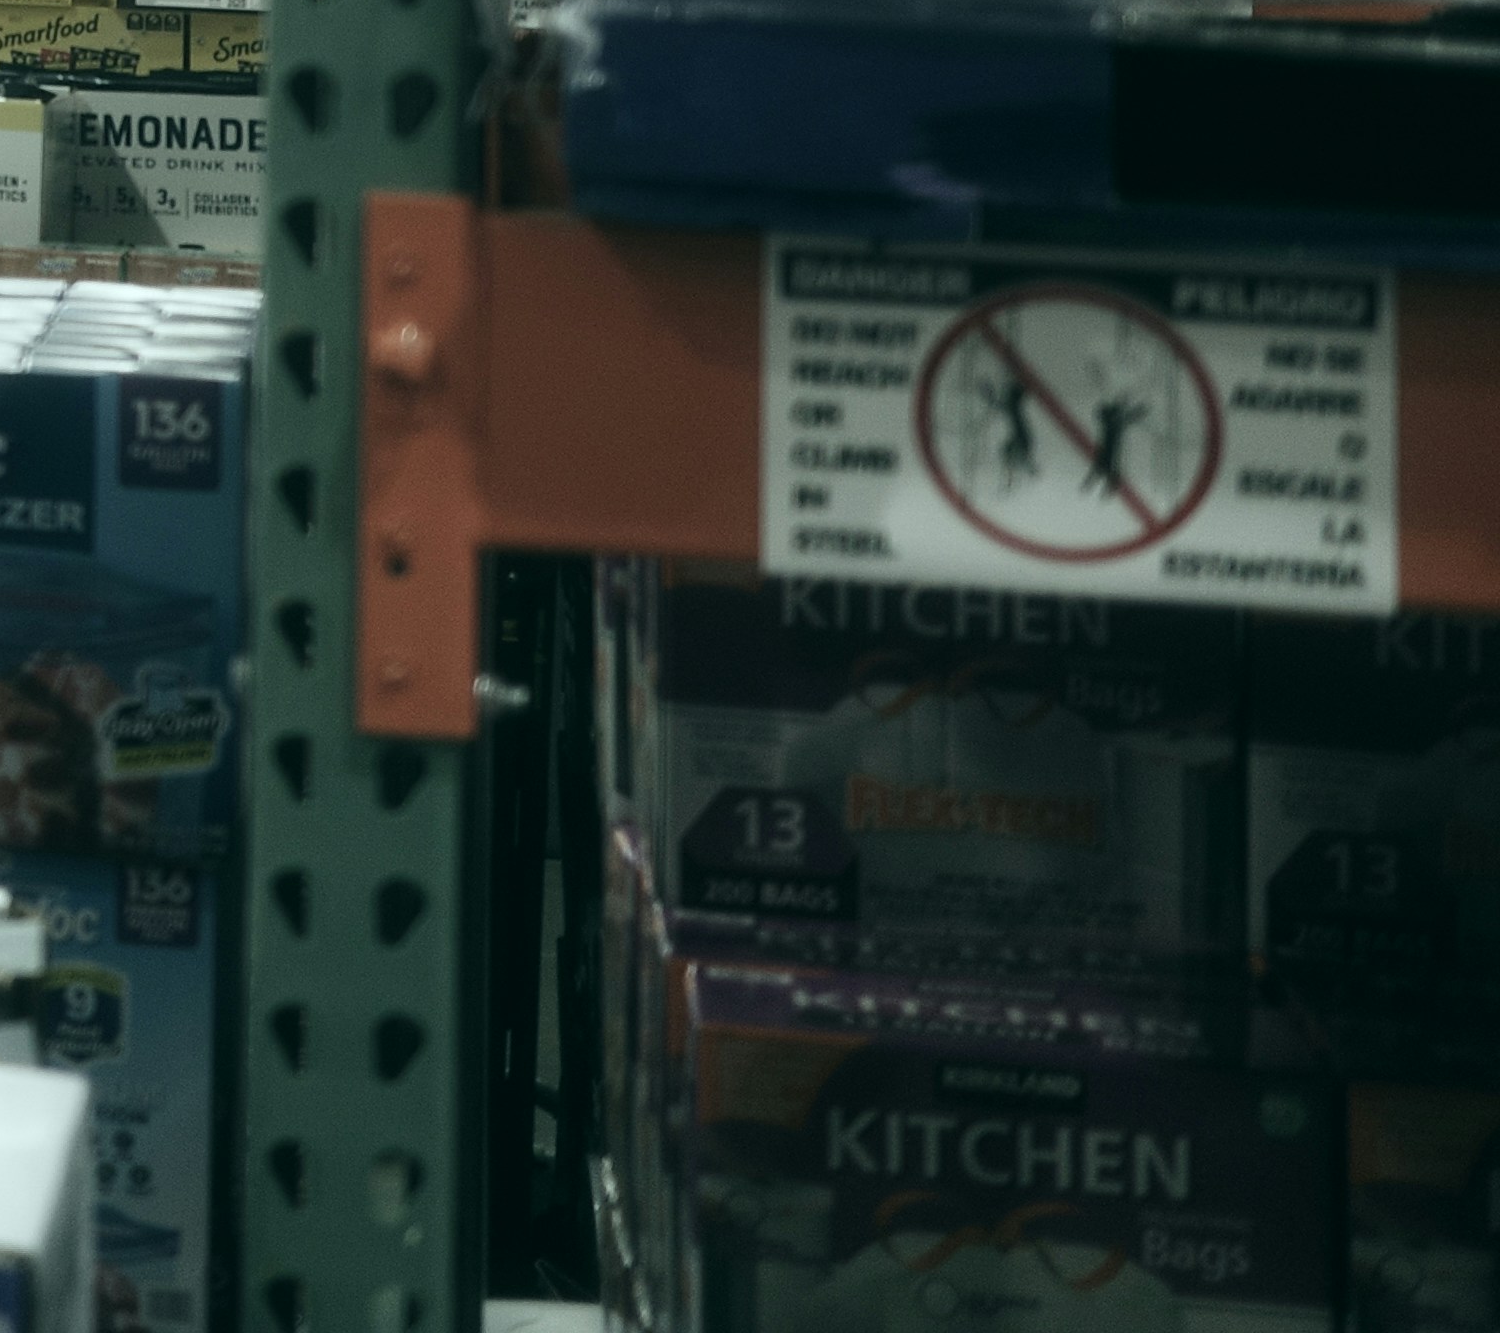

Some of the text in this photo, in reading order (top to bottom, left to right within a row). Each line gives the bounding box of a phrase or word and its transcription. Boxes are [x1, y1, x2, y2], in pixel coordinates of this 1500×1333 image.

[167, 157, 224, 172] DRINK
[132, 398, 210, 443] 136
[780, 580, 1111, 648] KITCHEN
[733, 796, 807, 856] 13
[123, 870, 191, 906] 136
[825, 1106, 1193, 1202] KITCHEN
[1140, 1228, 1252, 1282] Bags
